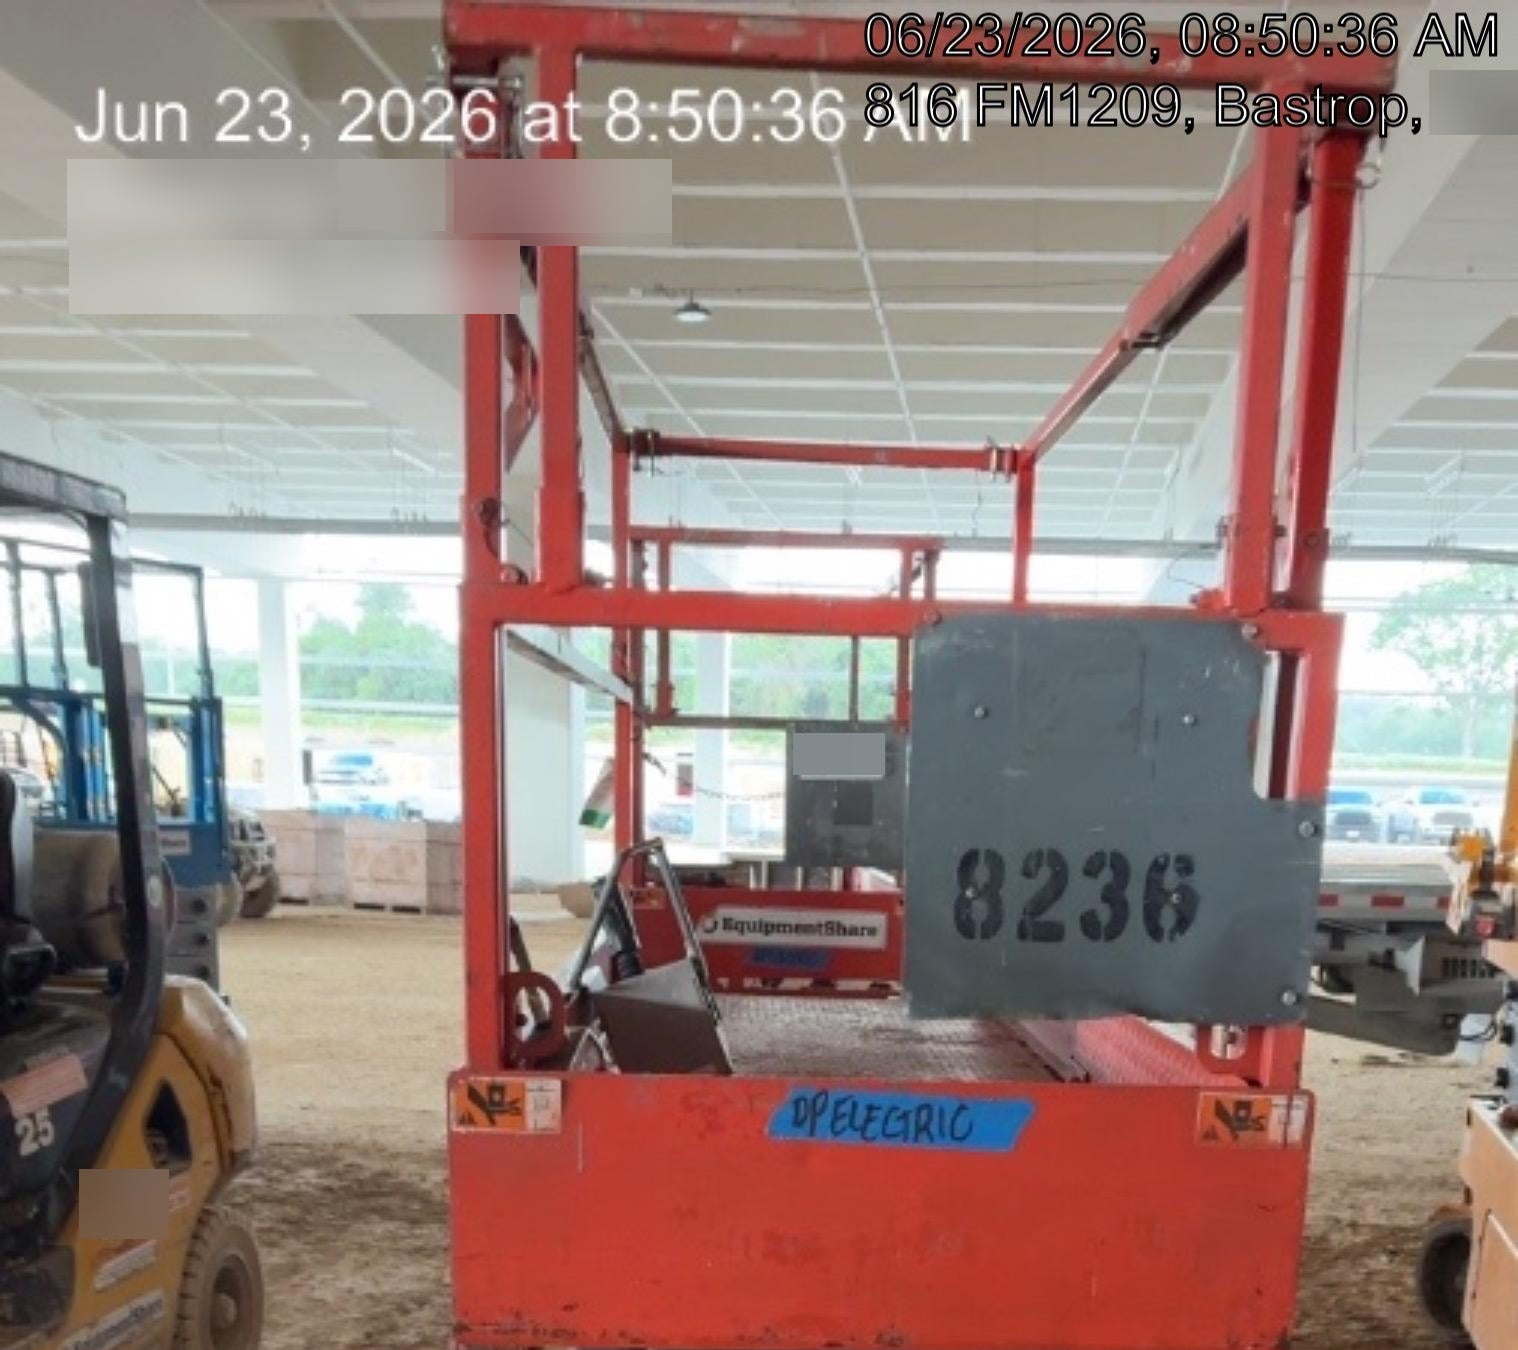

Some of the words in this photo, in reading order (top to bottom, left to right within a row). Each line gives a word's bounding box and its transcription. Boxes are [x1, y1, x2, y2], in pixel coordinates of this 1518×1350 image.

[953, 848, 1199, 943] 8236
[721, 916, 878, 938] EquipmentShare
[13, 1108, 55, 1157] 25
